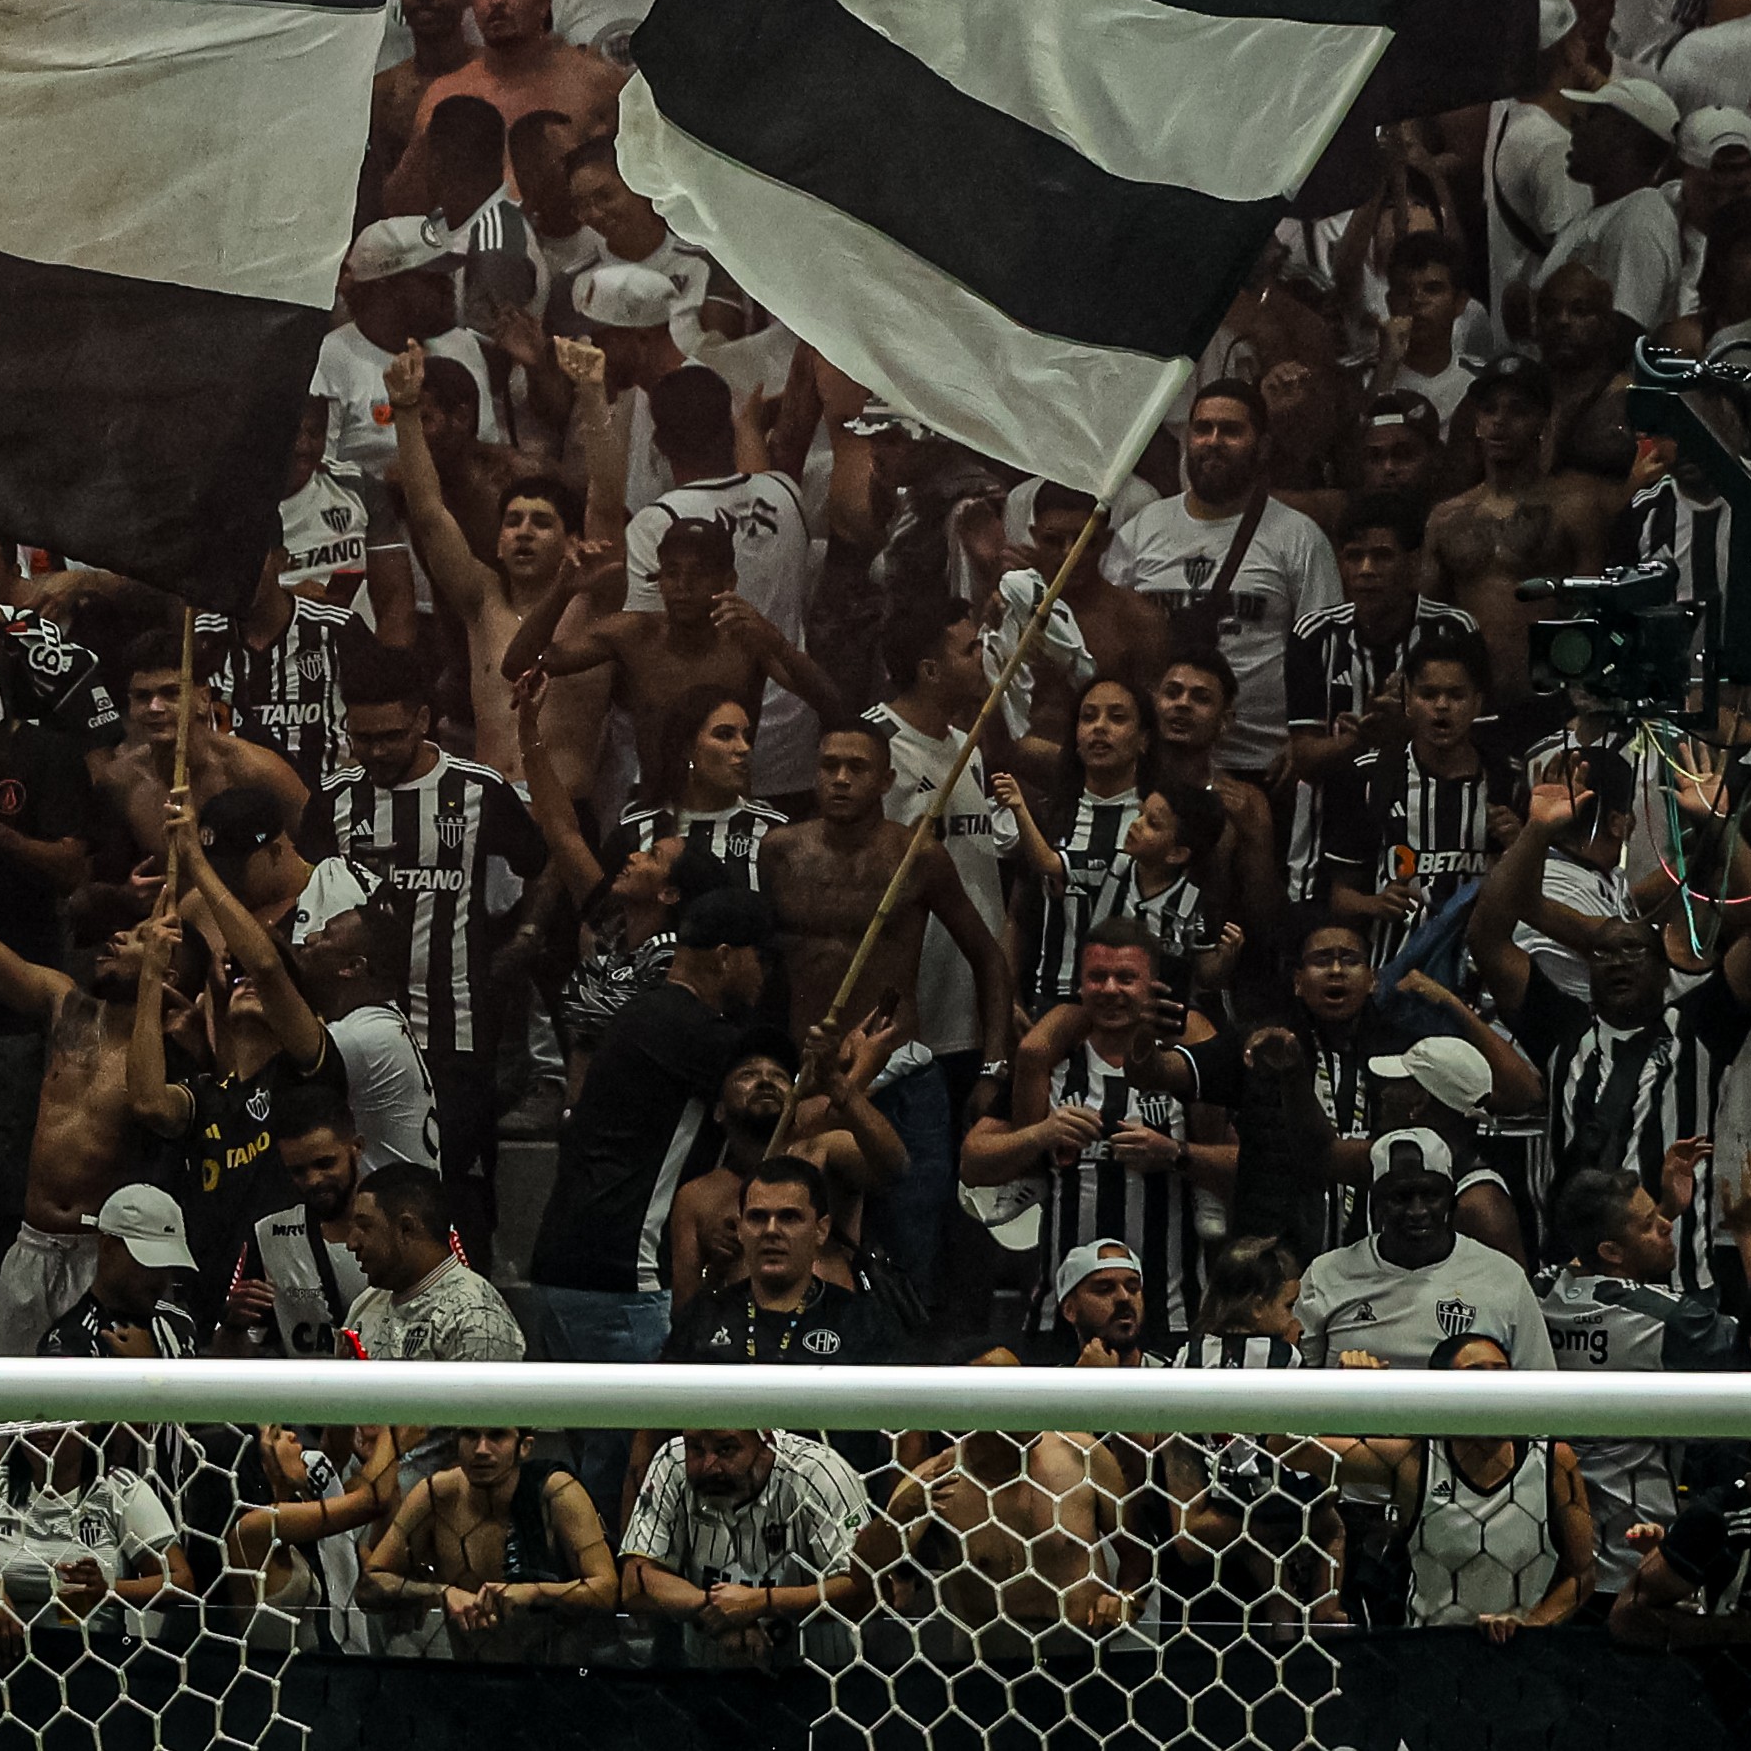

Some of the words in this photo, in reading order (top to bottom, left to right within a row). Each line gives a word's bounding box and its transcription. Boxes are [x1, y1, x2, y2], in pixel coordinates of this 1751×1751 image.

[290, 538, 362, 570] ETANO
[252, 701, 321, 727] TANO
[1417, 851, 1487, 875] BETAN
[390, 865, 464, 892] ETANO
[225, 1130, 272, 1169] TANO
[291, 1322, 336, 1355] CA
[801, 1328, 842, 1354] CAM
